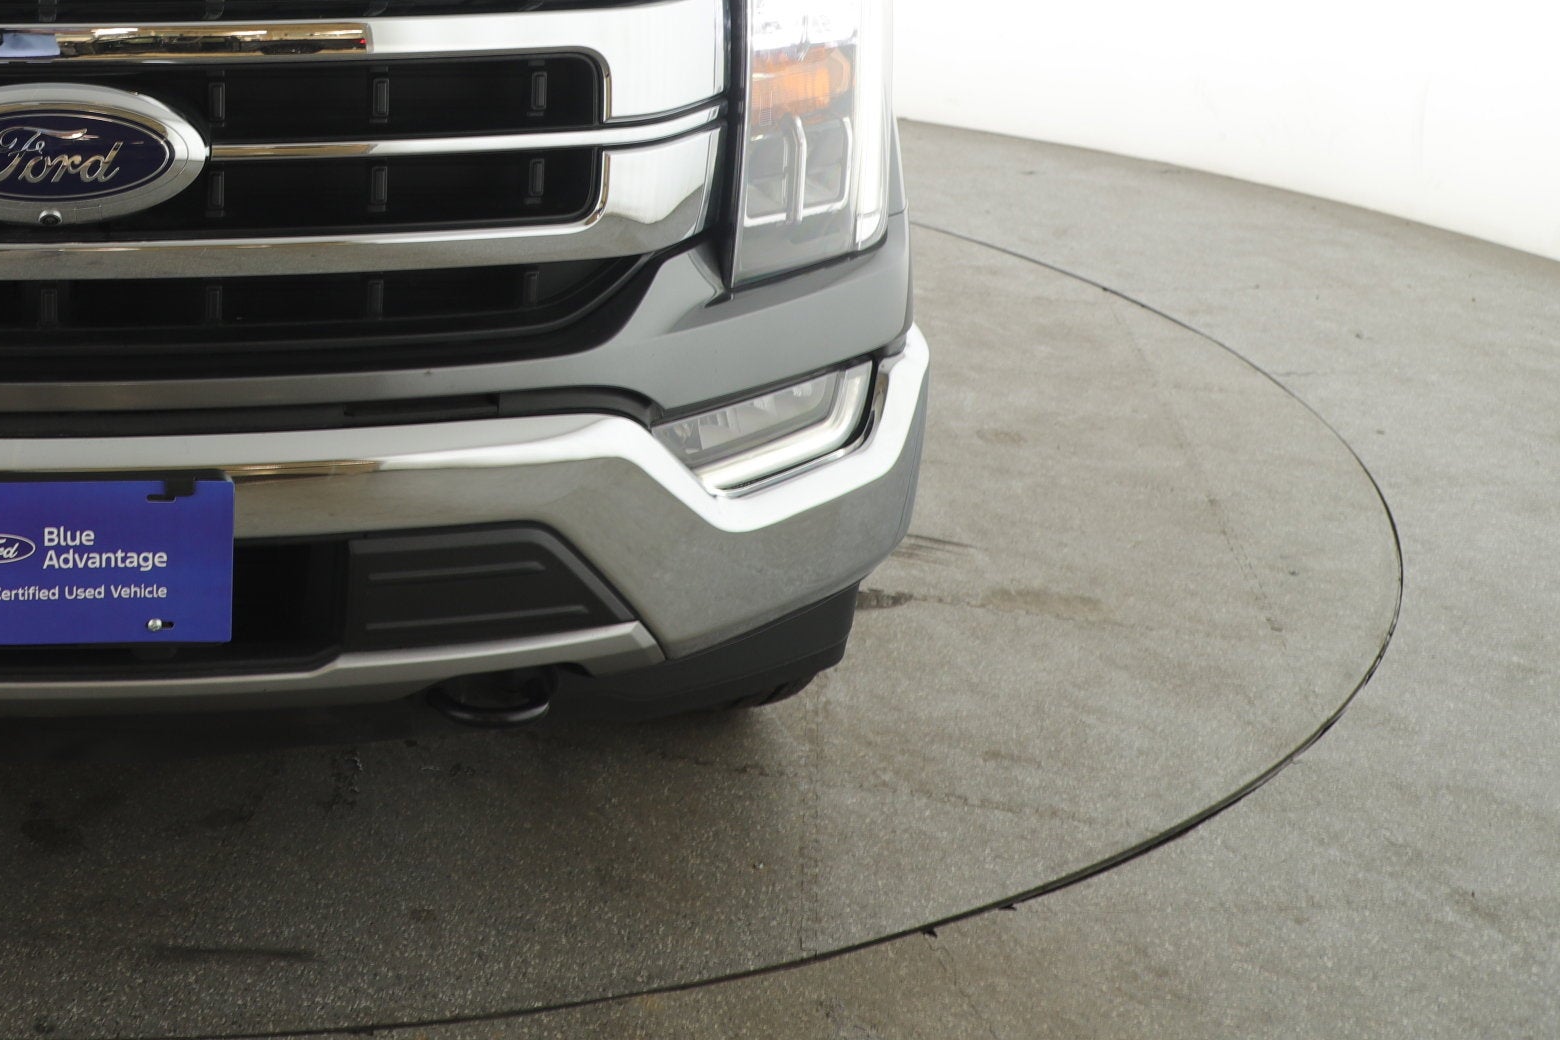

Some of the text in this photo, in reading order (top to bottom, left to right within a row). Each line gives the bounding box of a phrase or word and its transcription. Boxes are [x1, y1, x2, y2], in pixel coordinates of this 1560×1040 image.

[43, 526, 95, 547] Blue
[42, 547, 168, 572] Advantage
[64, 584, 105, 600] Used
[110, 583, 168, 599] Vehicle
